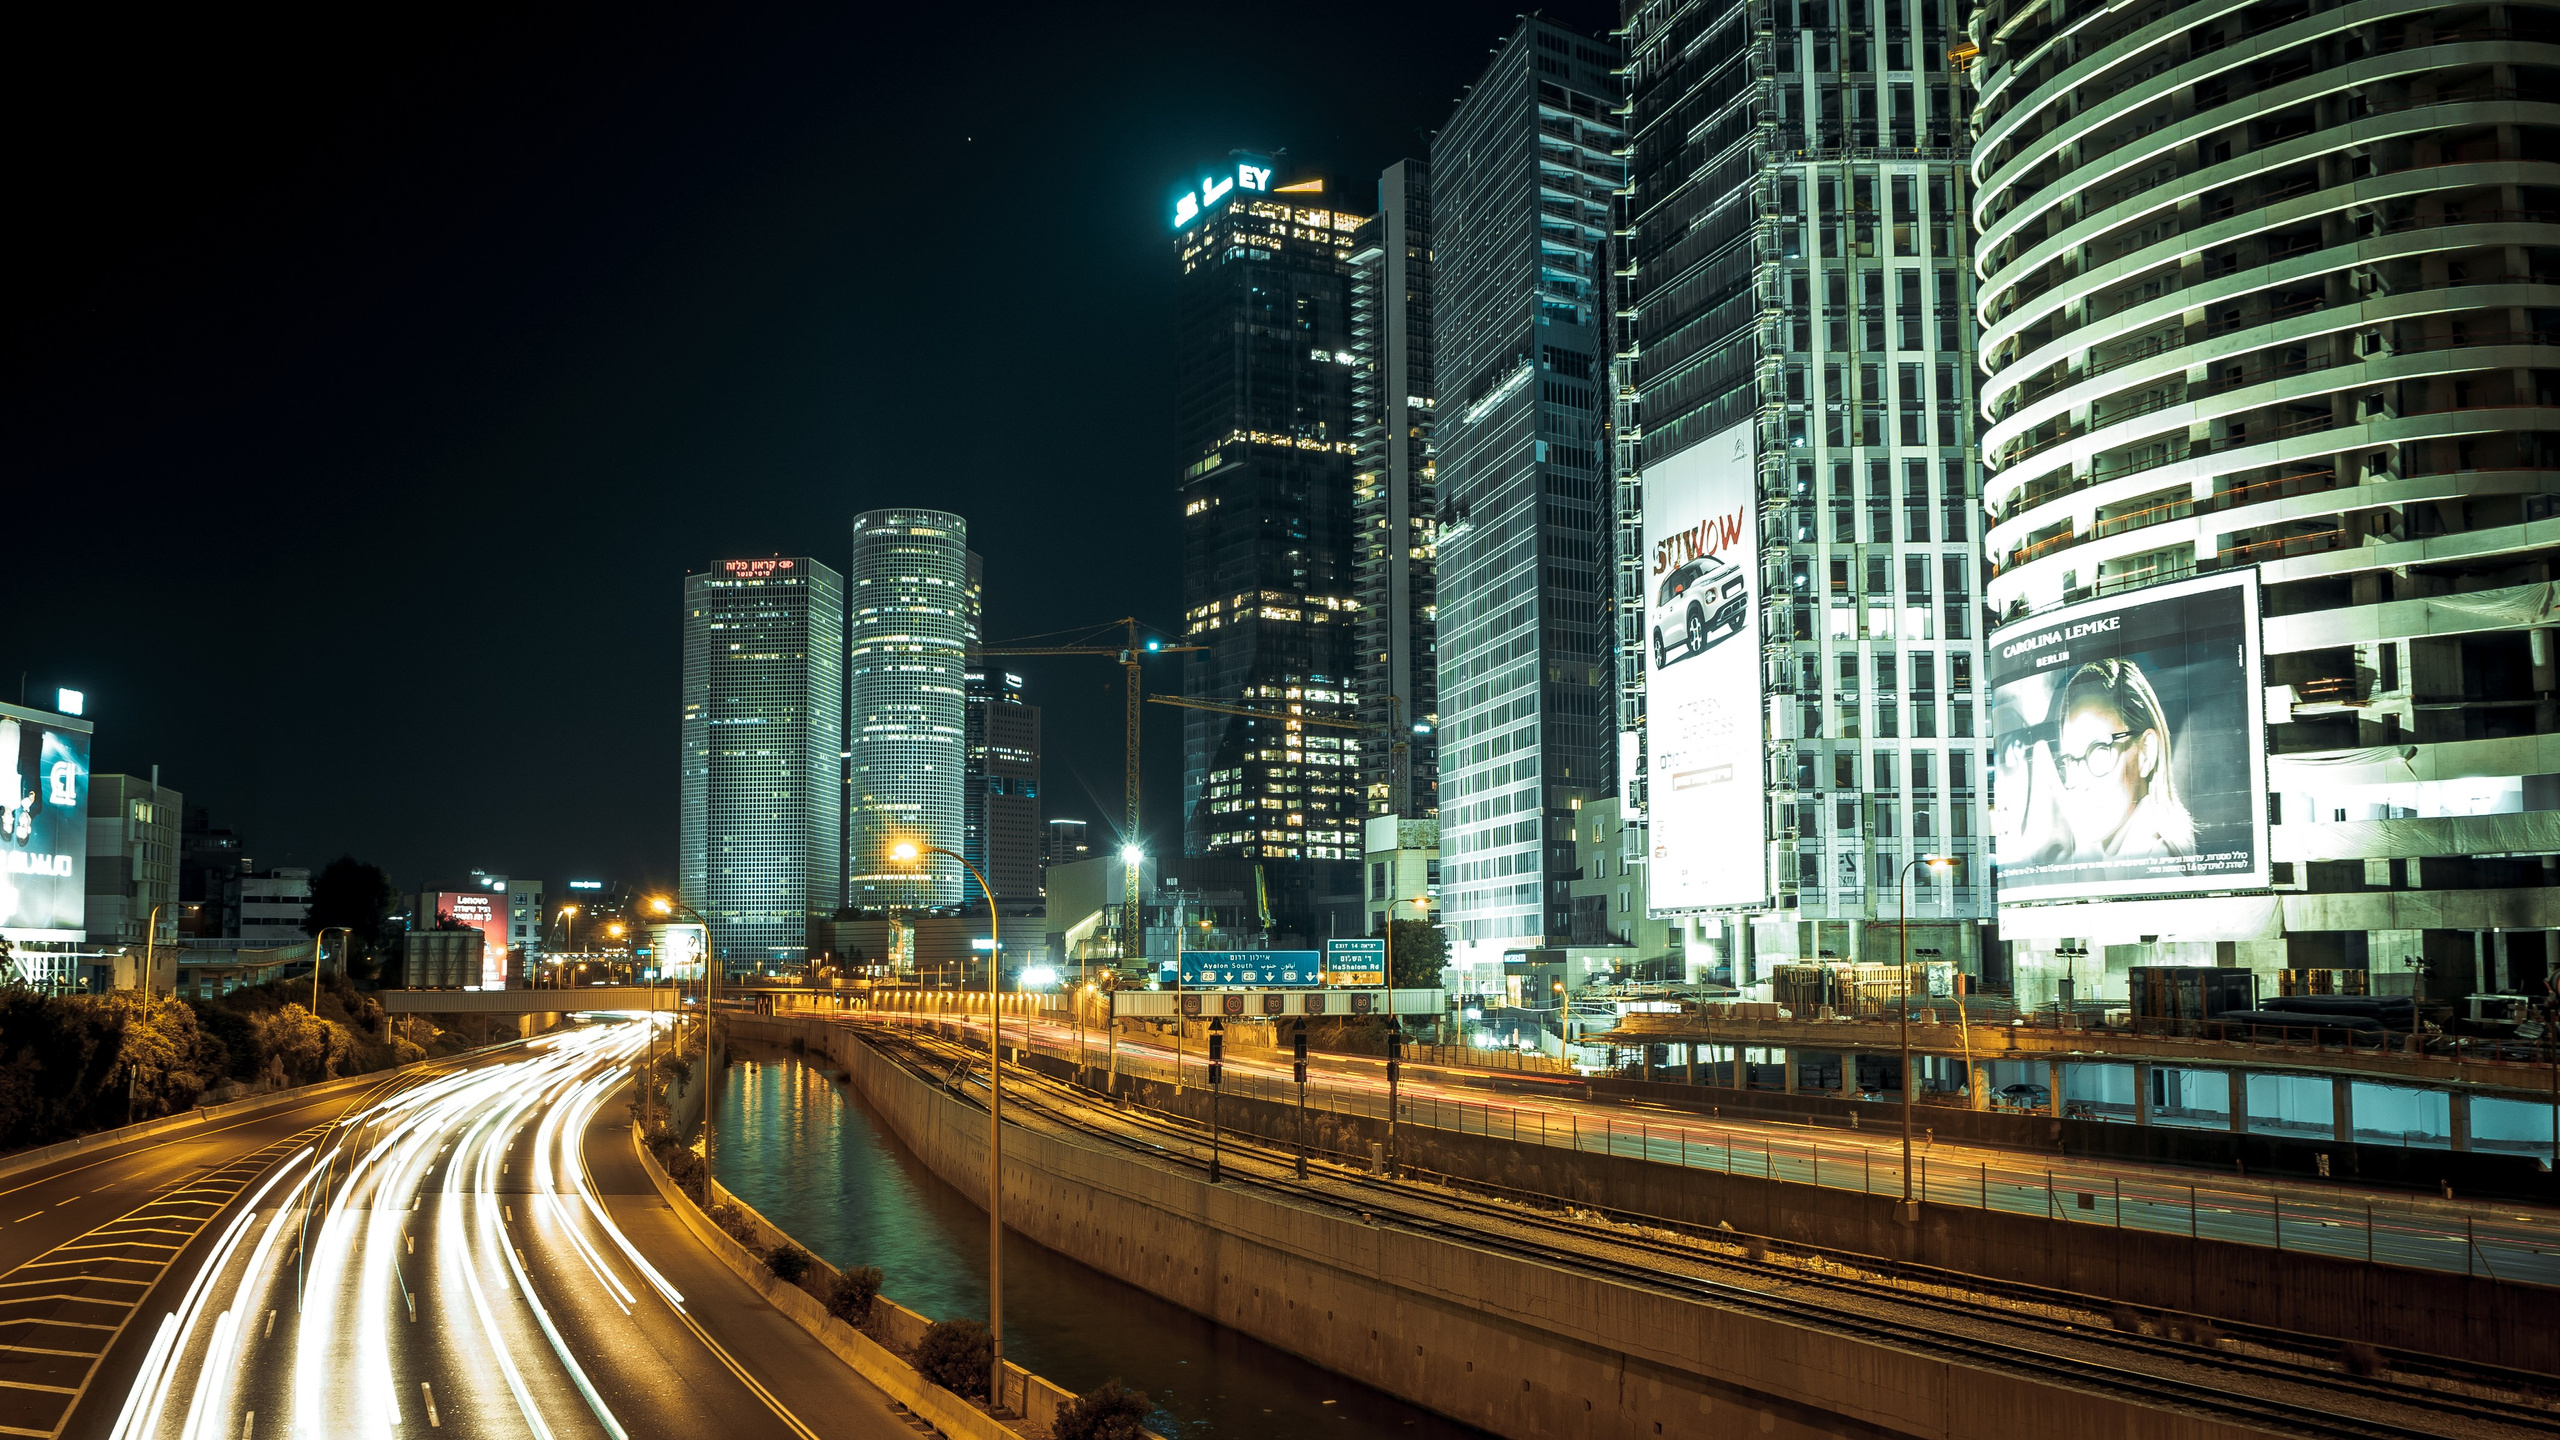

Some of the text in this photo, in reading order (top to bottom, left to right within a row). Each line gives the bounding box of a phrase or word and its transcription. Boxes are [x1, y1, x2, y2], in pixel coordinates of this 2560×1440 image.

[1239, 164, 1271, 191] EY
[726, 560, 776, 571] קראון פלזה
[2003, 616, 2121, 659] CAROLINA LEMKE
[2036, 651, 2069, 668] BERLIN
[457, 896, 488, 905] Lenovo
